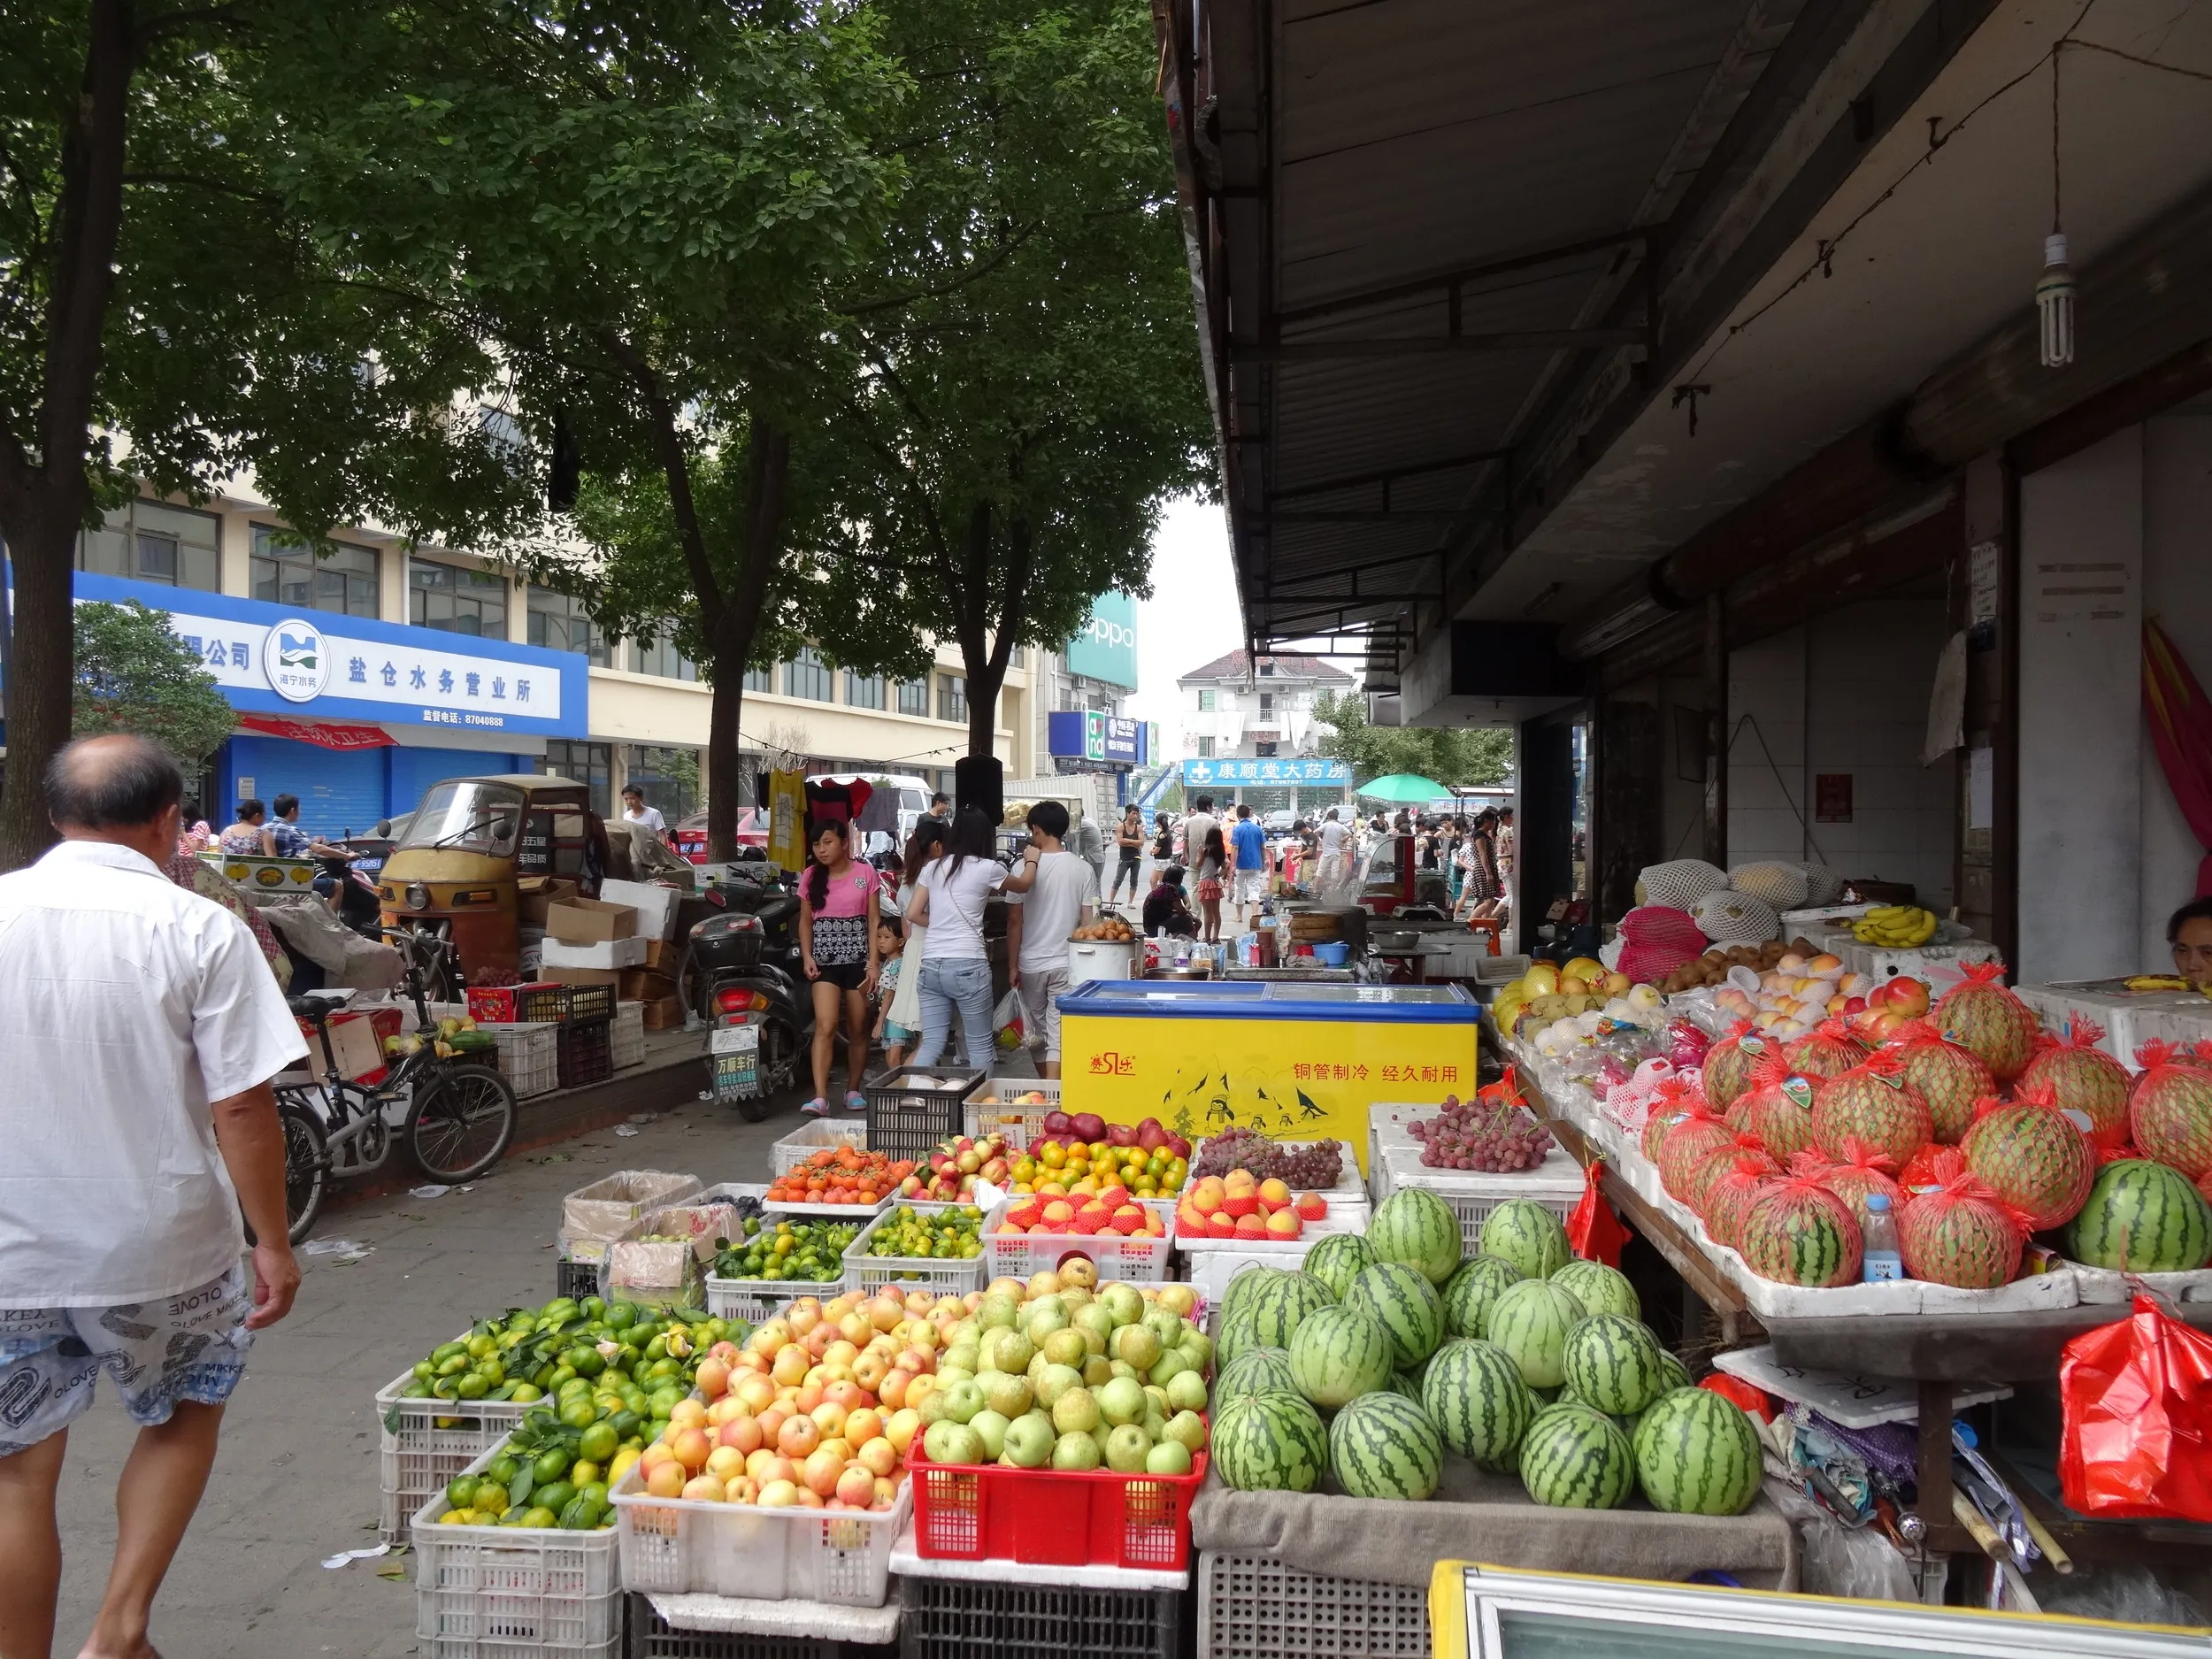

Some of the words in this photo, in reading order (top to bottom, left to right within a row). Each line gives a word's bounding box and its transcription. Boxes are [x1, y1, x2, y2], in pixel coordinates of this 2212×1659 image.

[280, 673, 317, 688] 海宁水务
[349, 657, 531, 703] 盐仓水务营业所
[1217, 762, 1346, 779] 康顺堂大药房
[718, 1054, 756, 1074] 万顺车行
[1294, 1063, 1369, 1081] 铜管制冷
[1382, 1064, 1457, 1083] 经久耐用
[54, 1365, 98, 1398] OLOVE
